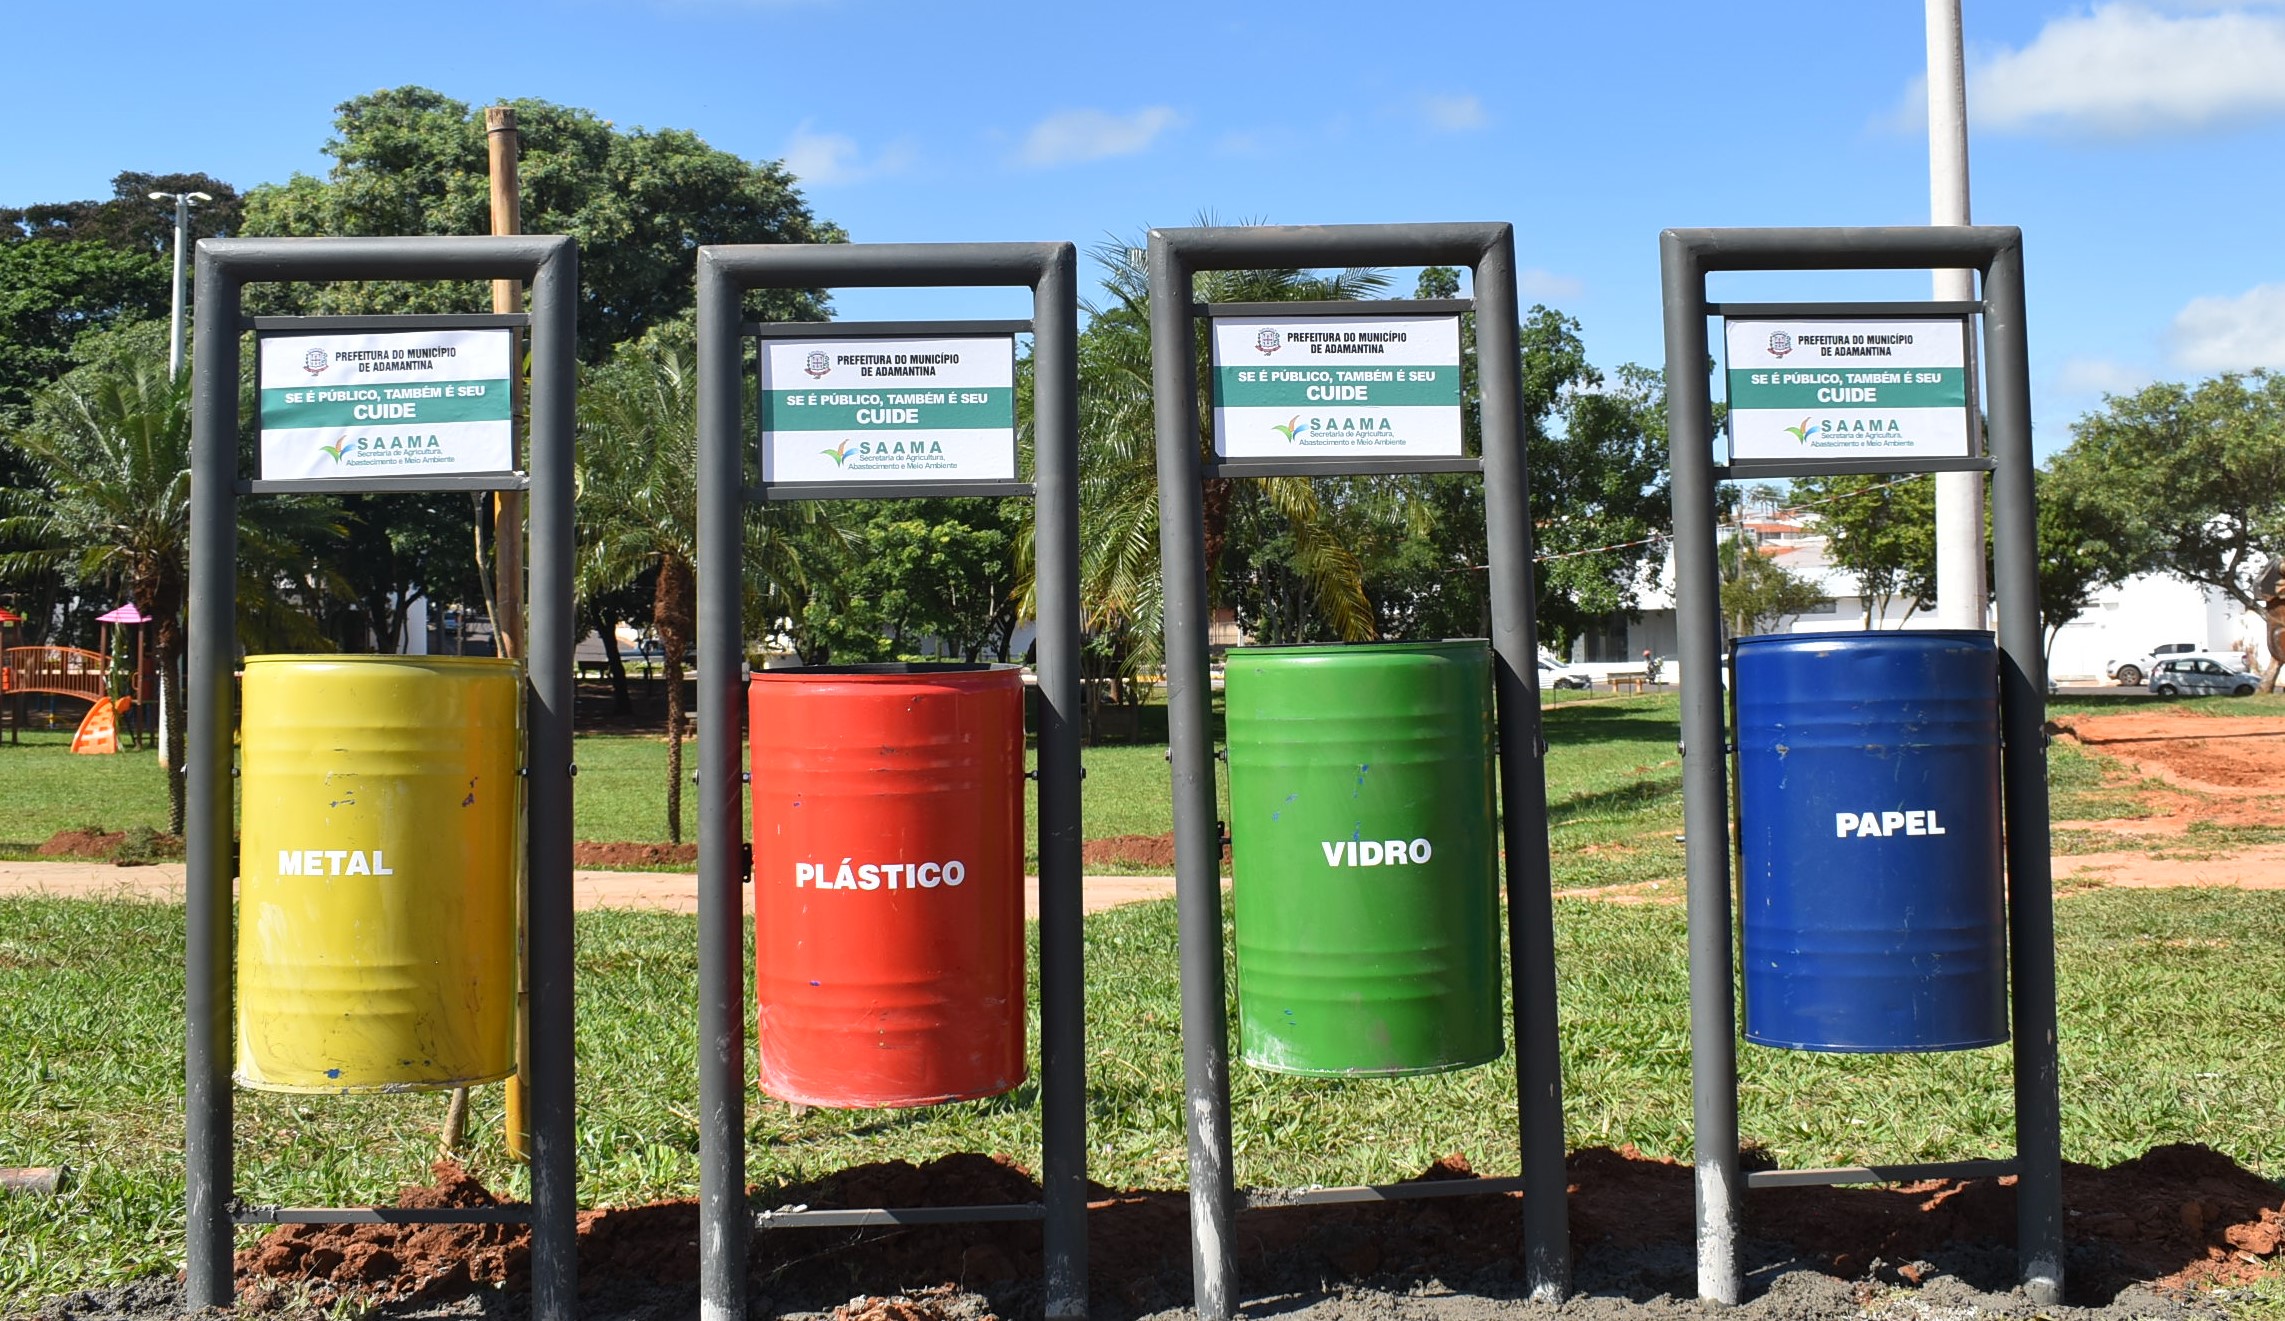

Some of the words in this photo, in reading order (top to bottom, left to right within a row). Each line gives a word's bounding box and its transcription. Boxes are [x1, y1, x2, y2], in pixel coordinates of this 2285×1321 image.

[1287, 333, 1340, 342] PREFEITURA
[1343, 333, 1356, 342] DO
[1359, 330, 1407, 342] MUNICÍPIO
[1798, 335, 1850, 345] PREFEITURA
[1853, 335, 1864, 344] DO
[1867, 333, 1913, 344] MUNICÍPIO
[335, 351, 389, 361] PREFEITURA
[392, 350, 405, 359] DO
[408, 347, 456, 358] MUNICÍPIO
[1310, 344, 1322, 354] DE
[1325, 344, 1384, 353] ADAMANTINA
[1821, 347, 1832, 356] DE
[1835, 346, 1891, 356] ADAMANTINA
[837, 355, 892, 365] PREFEITURA
[895, 355, 907, 364] DO
[910, 352, 959, 364] MUNICÍPIO
[358, 362, 370, 372] DE
[373, 361, 433, 372] ADAMANTINA
[861, 367, 873, 377] DE
[875, 367, 936, 376] ADAMANTINA
[1238, 372, 1256, 382] SE
[1259, 369, 1268, 381] É
[1271, 369, 1333, 383] PÚBLICO,
[1336, 369, 1393, 381] TAMBÉM
[1397, 369, 1405, 381] É
[1409, 371, 1435, 381] SEU
[1751, 375, 1768, 384] SE
[1772, 372, 1780, 384] É
[1784, 371, 1843, 385] PÚBLICO,
[1846, 371, 1900, 384] TAMBÉM
[1904, 371, 1912, 383] É
[1915, 373, 1941, 383] SEU
[285, 393, 302, 403] SE
[307, 390, 315, 402] É
[319, 389, 381, 402] PÚBLICO,
[384, 386, 442, 399] TAMBÉM
[446, 386, 454, 397] É
[458, 386, 485, 396] SEU
[787, 395, 804, 406] SE
[808, 393, 817, 405] É
[821, 392, 883, 407] PÚBLICO,
[887, 392, 944, 404] TAMBÉM
[948, 391, 957, 403] É
[961, 394, 987, 403] SEU
[1306, 386, 1367, 400] CUIDE
[1817, 388, 1876, 402] CUIDE
[354, 403, 416, 419] CUIDE
[856, 409, 919, 424] CUIDE
[1310, 418, 1391, 430] SAAMA
[1821, 420, 1899, 432] SAAMA
[358, 435, 439, 449] SAAMA
[1356, 431, 1394, 439] Agricultura,
[1865, 432, 1902, 440] Agricultura,
[860, 441, 942, 454] SAAMA
[906, 454, 945, 462] Agricultura,
[1836, 810, 1945, 837] PAPEL
[1321, 838, 1432, 867] VIDRO
[278, 850, 394, 877] METAL
[795, 858, 965, 890] PLÁSTICO
